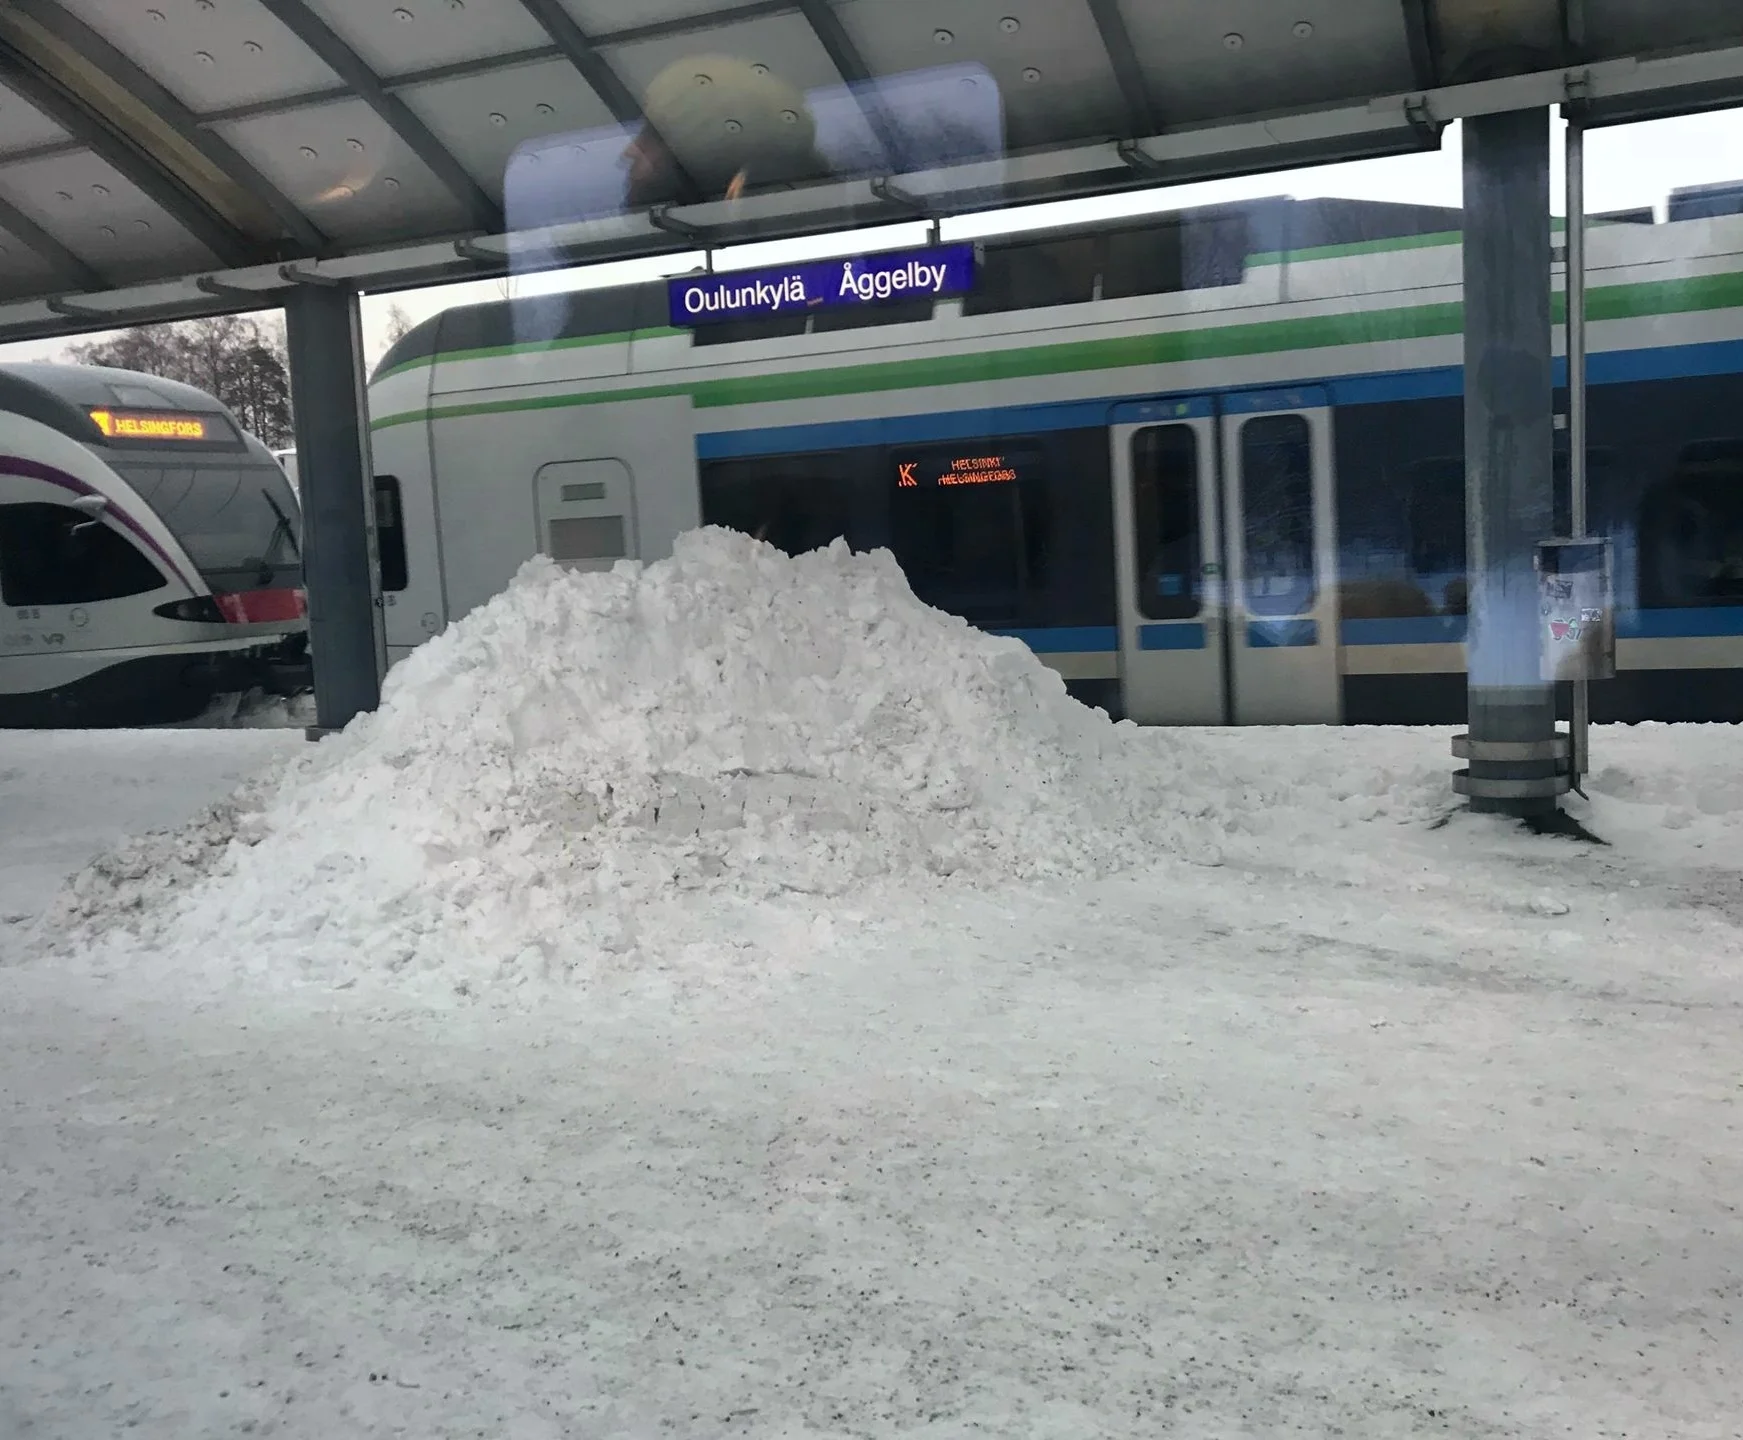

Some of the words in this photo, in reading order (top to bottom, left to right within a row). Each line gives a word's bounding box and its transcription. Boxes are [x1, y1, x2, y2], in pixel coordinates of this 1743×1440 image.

[685, 276, 805, 313] Oulunkylä
[839, 262, 947, 299] Åggelby
[115, 418, 203, 438] HELSINGFORS
[950, 456, 1004, 470] HELSINKI
[898, 463, 918, 487] K
[42, 633, 65, 645] VR
